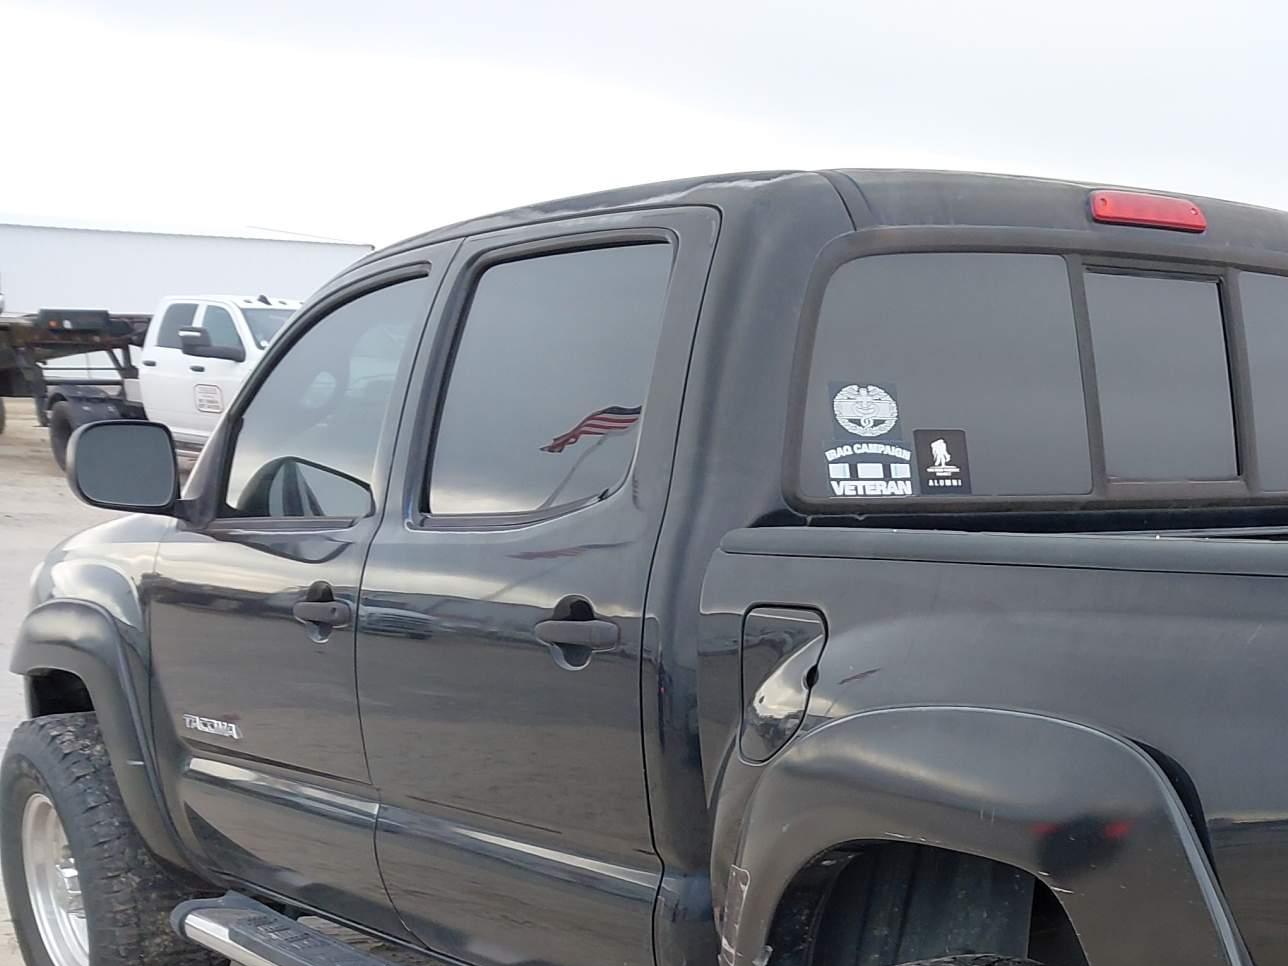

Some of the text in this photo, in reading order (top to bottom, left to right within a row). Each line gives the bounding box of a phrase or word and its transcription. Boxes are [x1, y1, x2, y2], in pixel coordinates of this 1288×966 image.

[825, 443, 912, 461] IRAQ CAMPAIGN
[830, 480, 913, 496] VETERAN
[928, 479, 962, 487] ALUMNI
[183, 713, 243, 739] TACOMA
